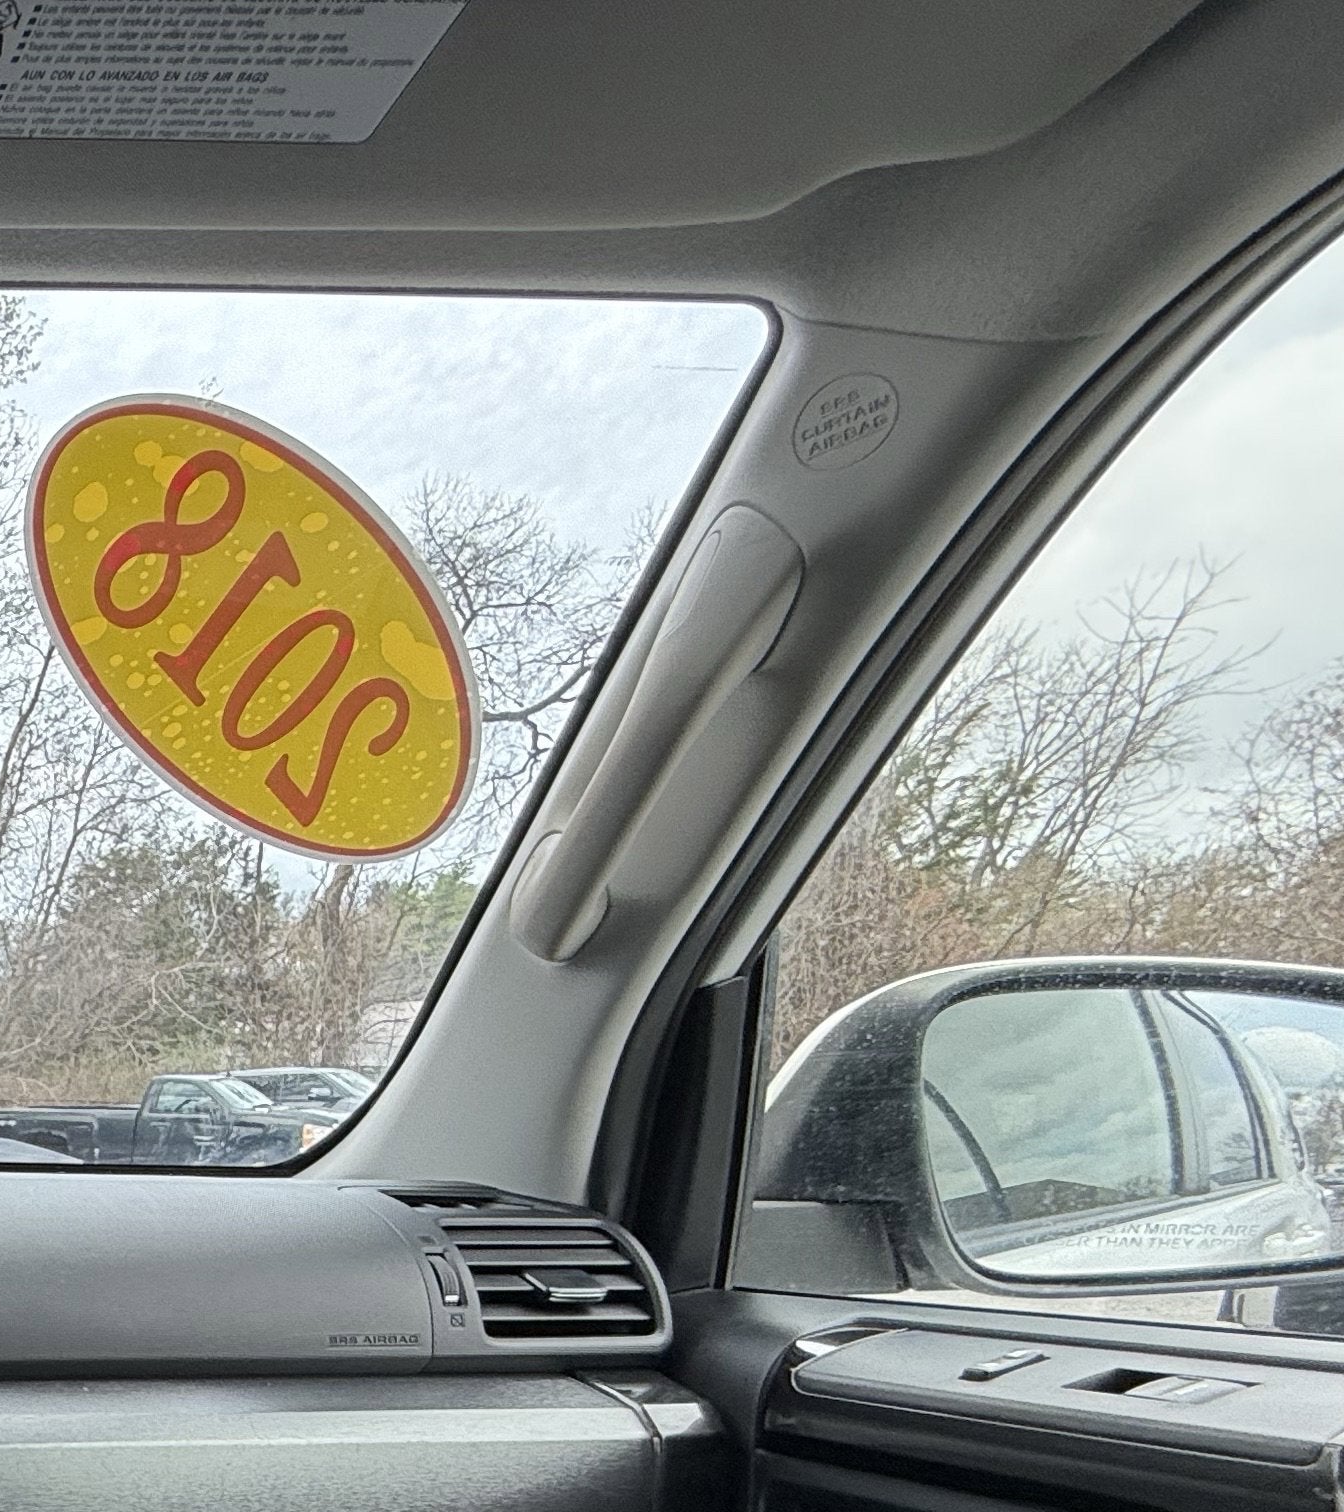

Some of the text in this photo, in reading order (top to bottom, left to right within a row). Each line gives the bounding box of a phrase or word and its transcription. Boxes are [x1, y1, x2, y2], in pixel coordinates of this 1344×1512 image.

[20, 70, 46, 81] AUN
[50, 70, 75, 81] CON
[78, 70, 95, 81] LO
[162, 71, 179, 81] EN
[1145, 1223, 1218, 1236] MIRROR
[1222, 1223, 1260, 1236] ARE
[1095, 1235, 1145, 1248] THAN
[1146, 1237, 1193, 1249] THEY
